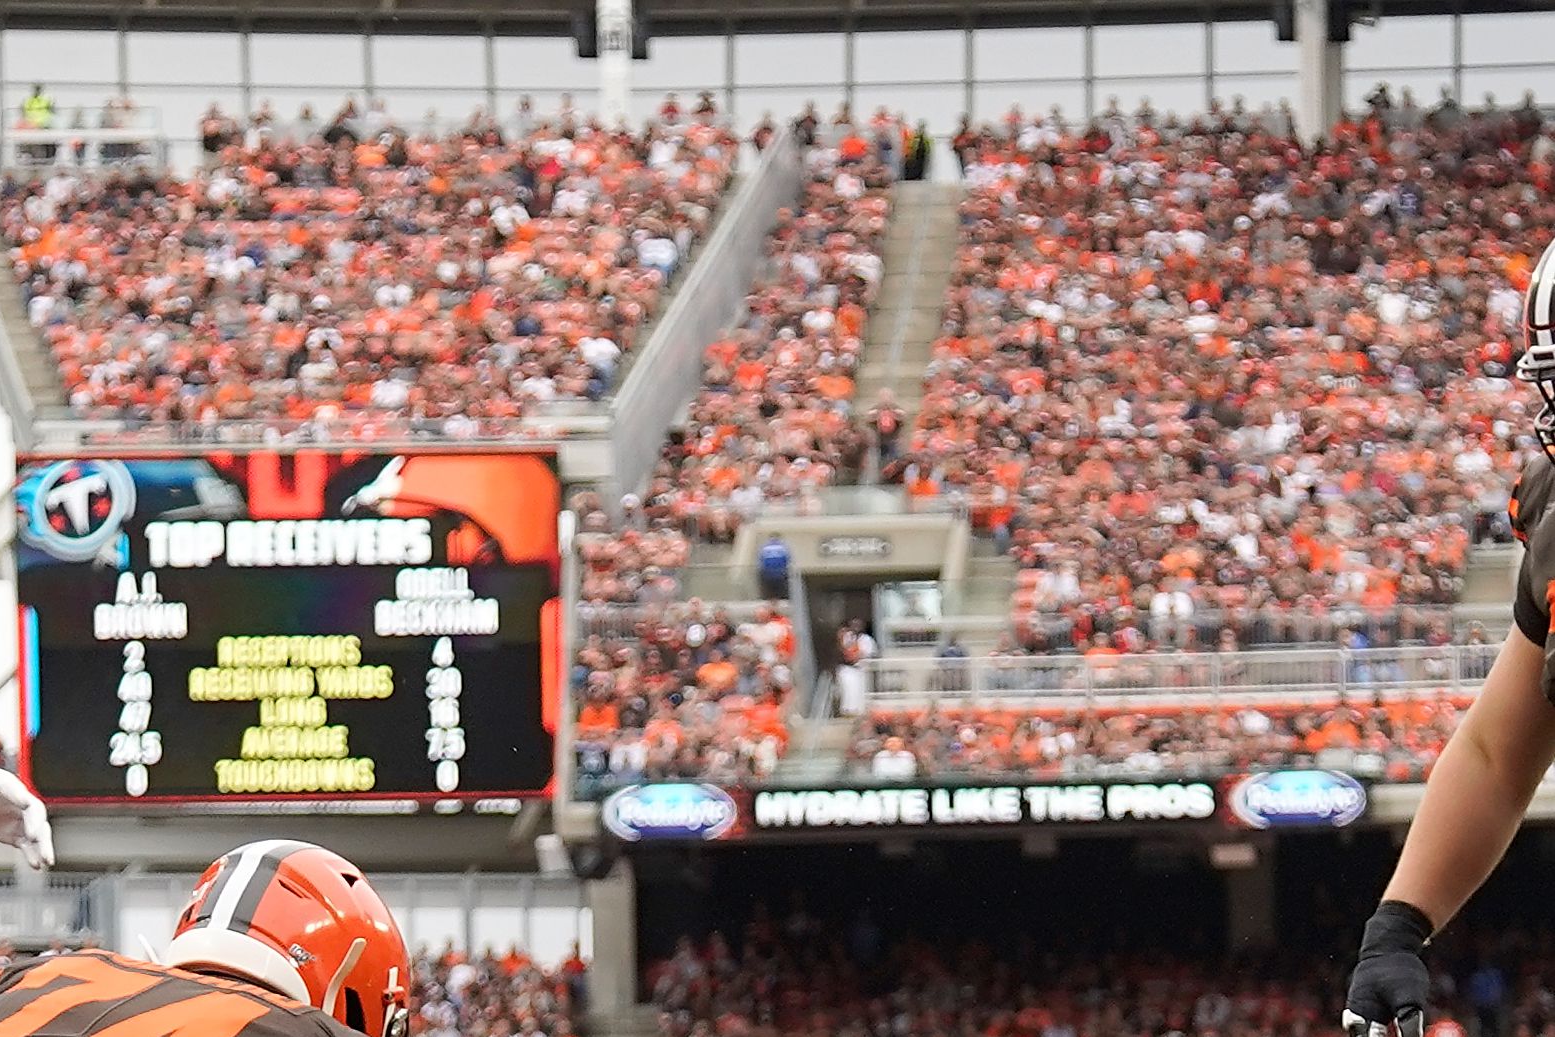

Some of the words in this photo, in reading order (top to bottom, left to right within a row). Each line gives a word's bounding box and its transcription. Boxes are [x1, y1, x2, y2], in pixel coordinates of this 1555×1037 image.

[145, 521, 225, 567] TOP
[226, 519, 432, 566] RECEIVERS
[755, 789, 929, 828] HYDRATE
[931, 786, 1023, 824] LIKE
[1023, 785, 1105, 821] THE
[1106, 783, 1215, 820] PROS
